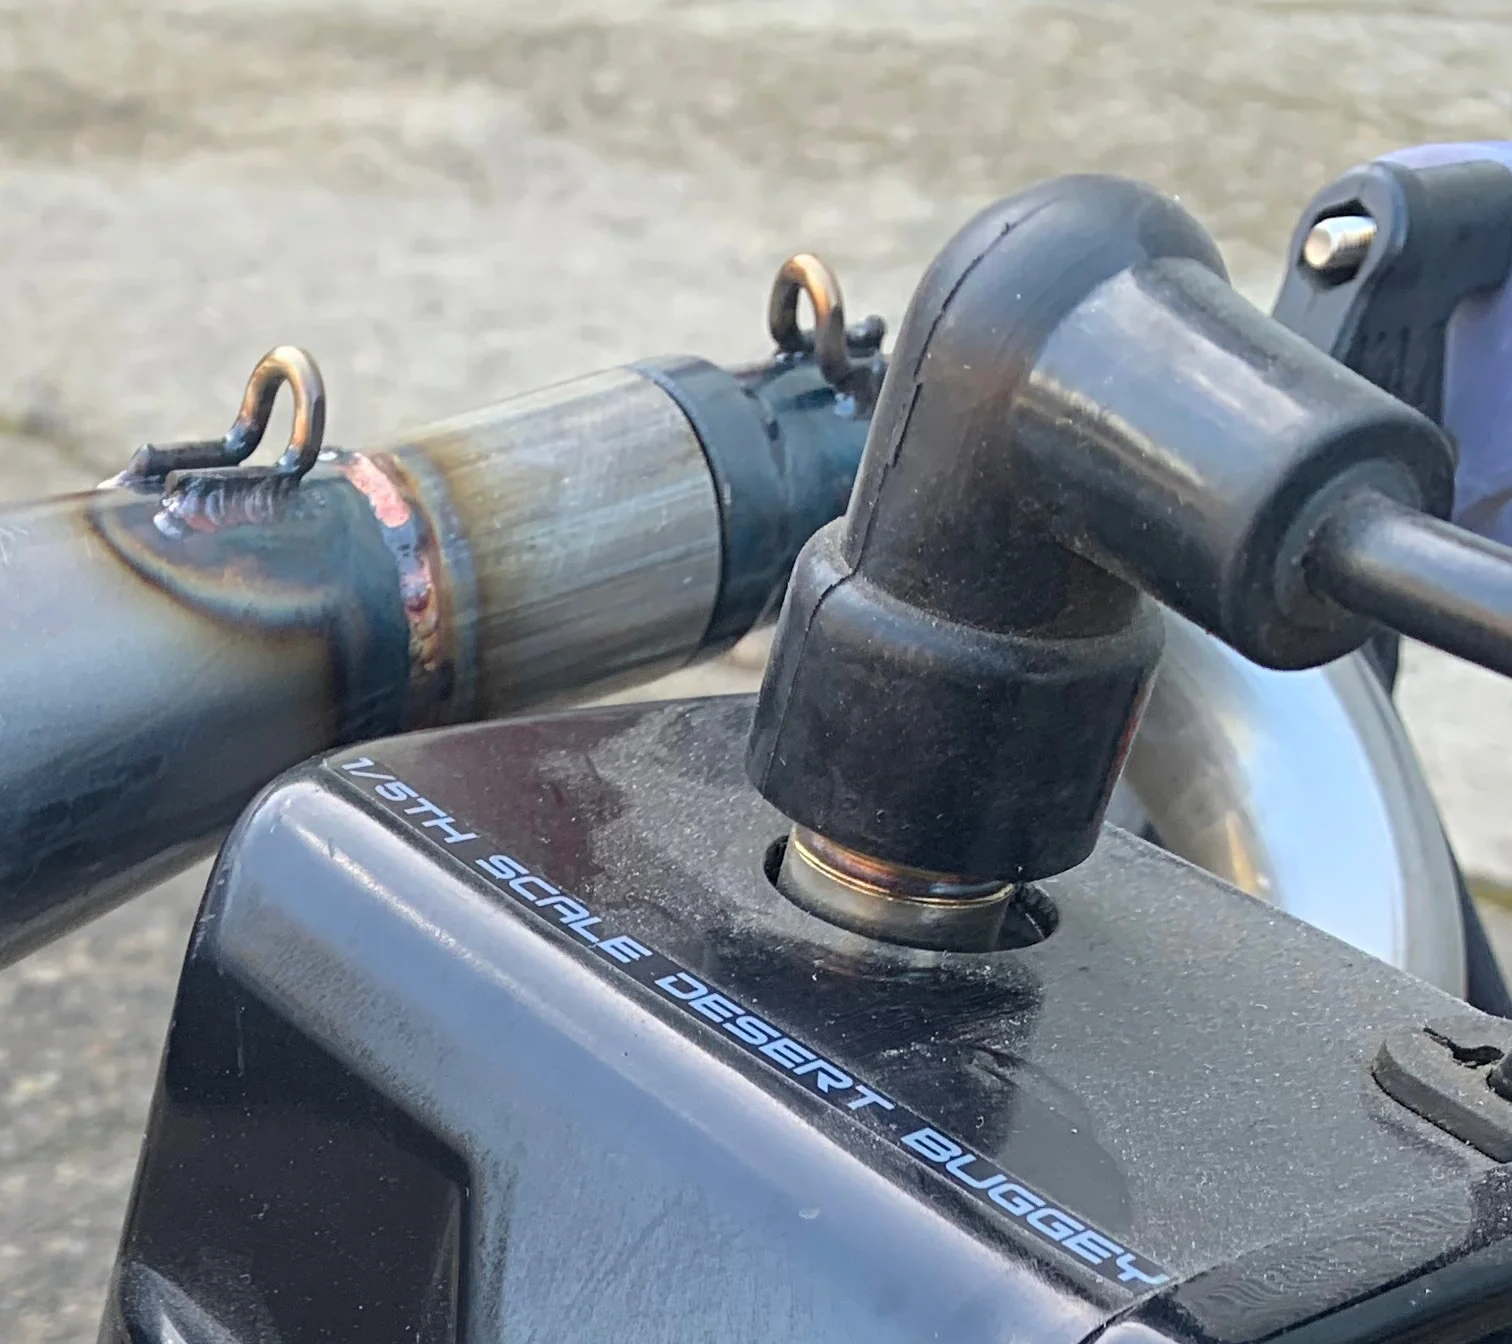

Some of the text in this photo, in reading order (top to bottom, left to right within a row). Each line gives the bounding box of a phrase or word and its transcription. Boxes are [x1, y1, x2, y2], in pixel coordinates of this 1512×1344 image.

[341, 756, 1170, 1286] 1/5TH SCALE DESERT BUGGEY
